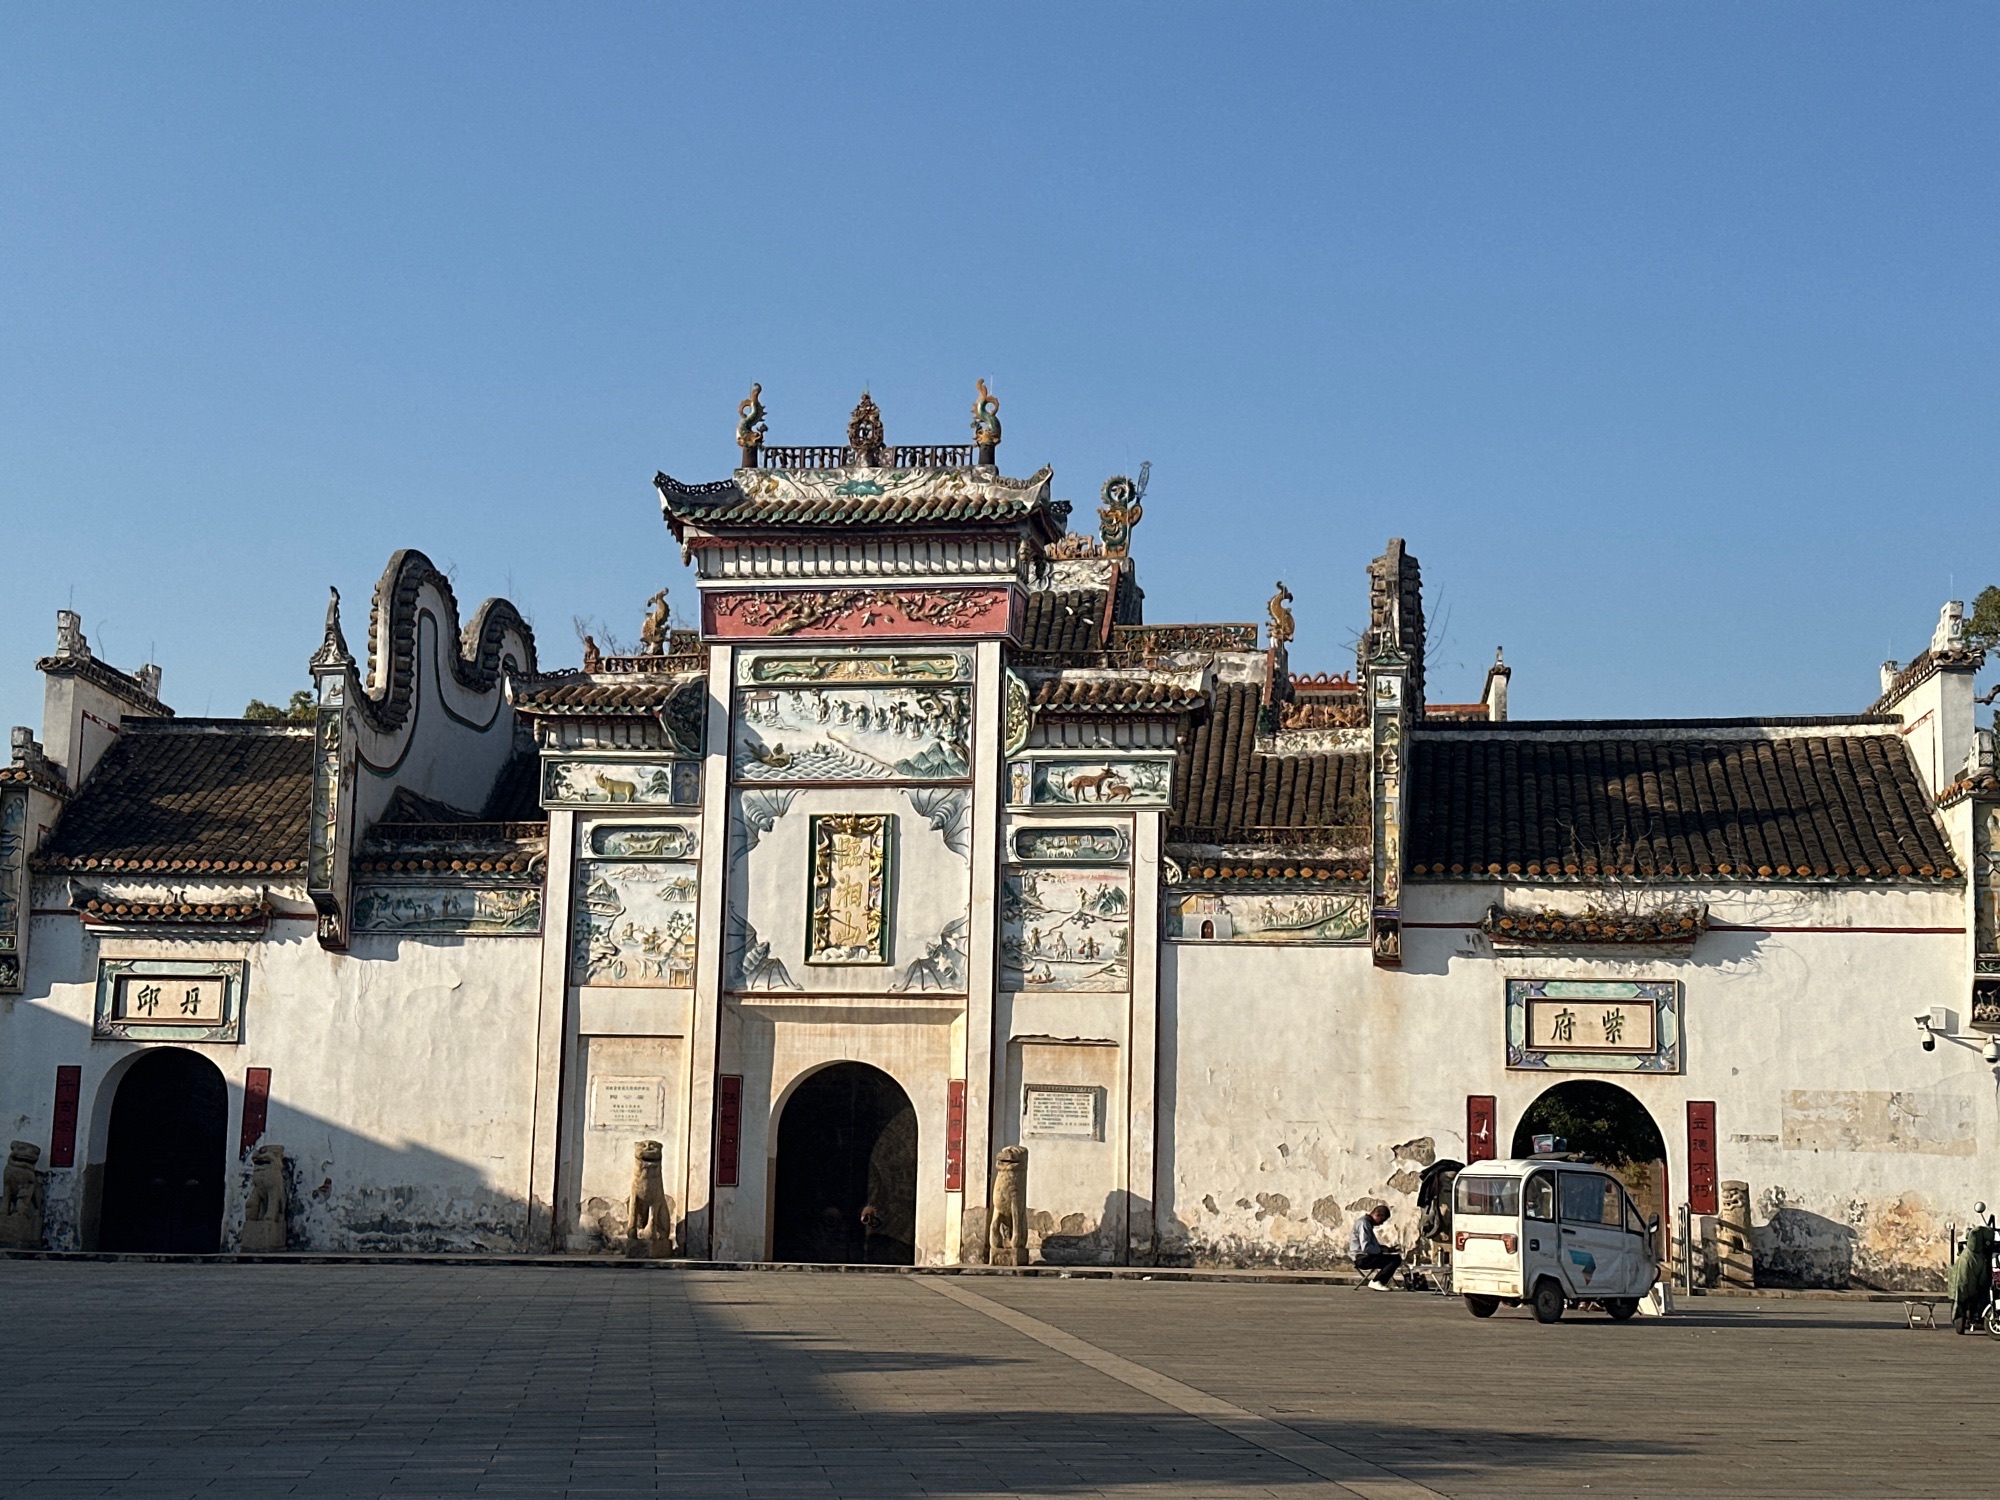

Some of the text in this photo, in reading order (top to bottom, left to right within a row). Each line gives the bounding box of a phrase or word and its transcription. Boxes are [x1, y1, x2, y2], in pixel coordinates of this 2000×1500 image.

[835, 836, 864, 945] 臨湘山
[1551, 1007, 1626, 1044] 紫府
